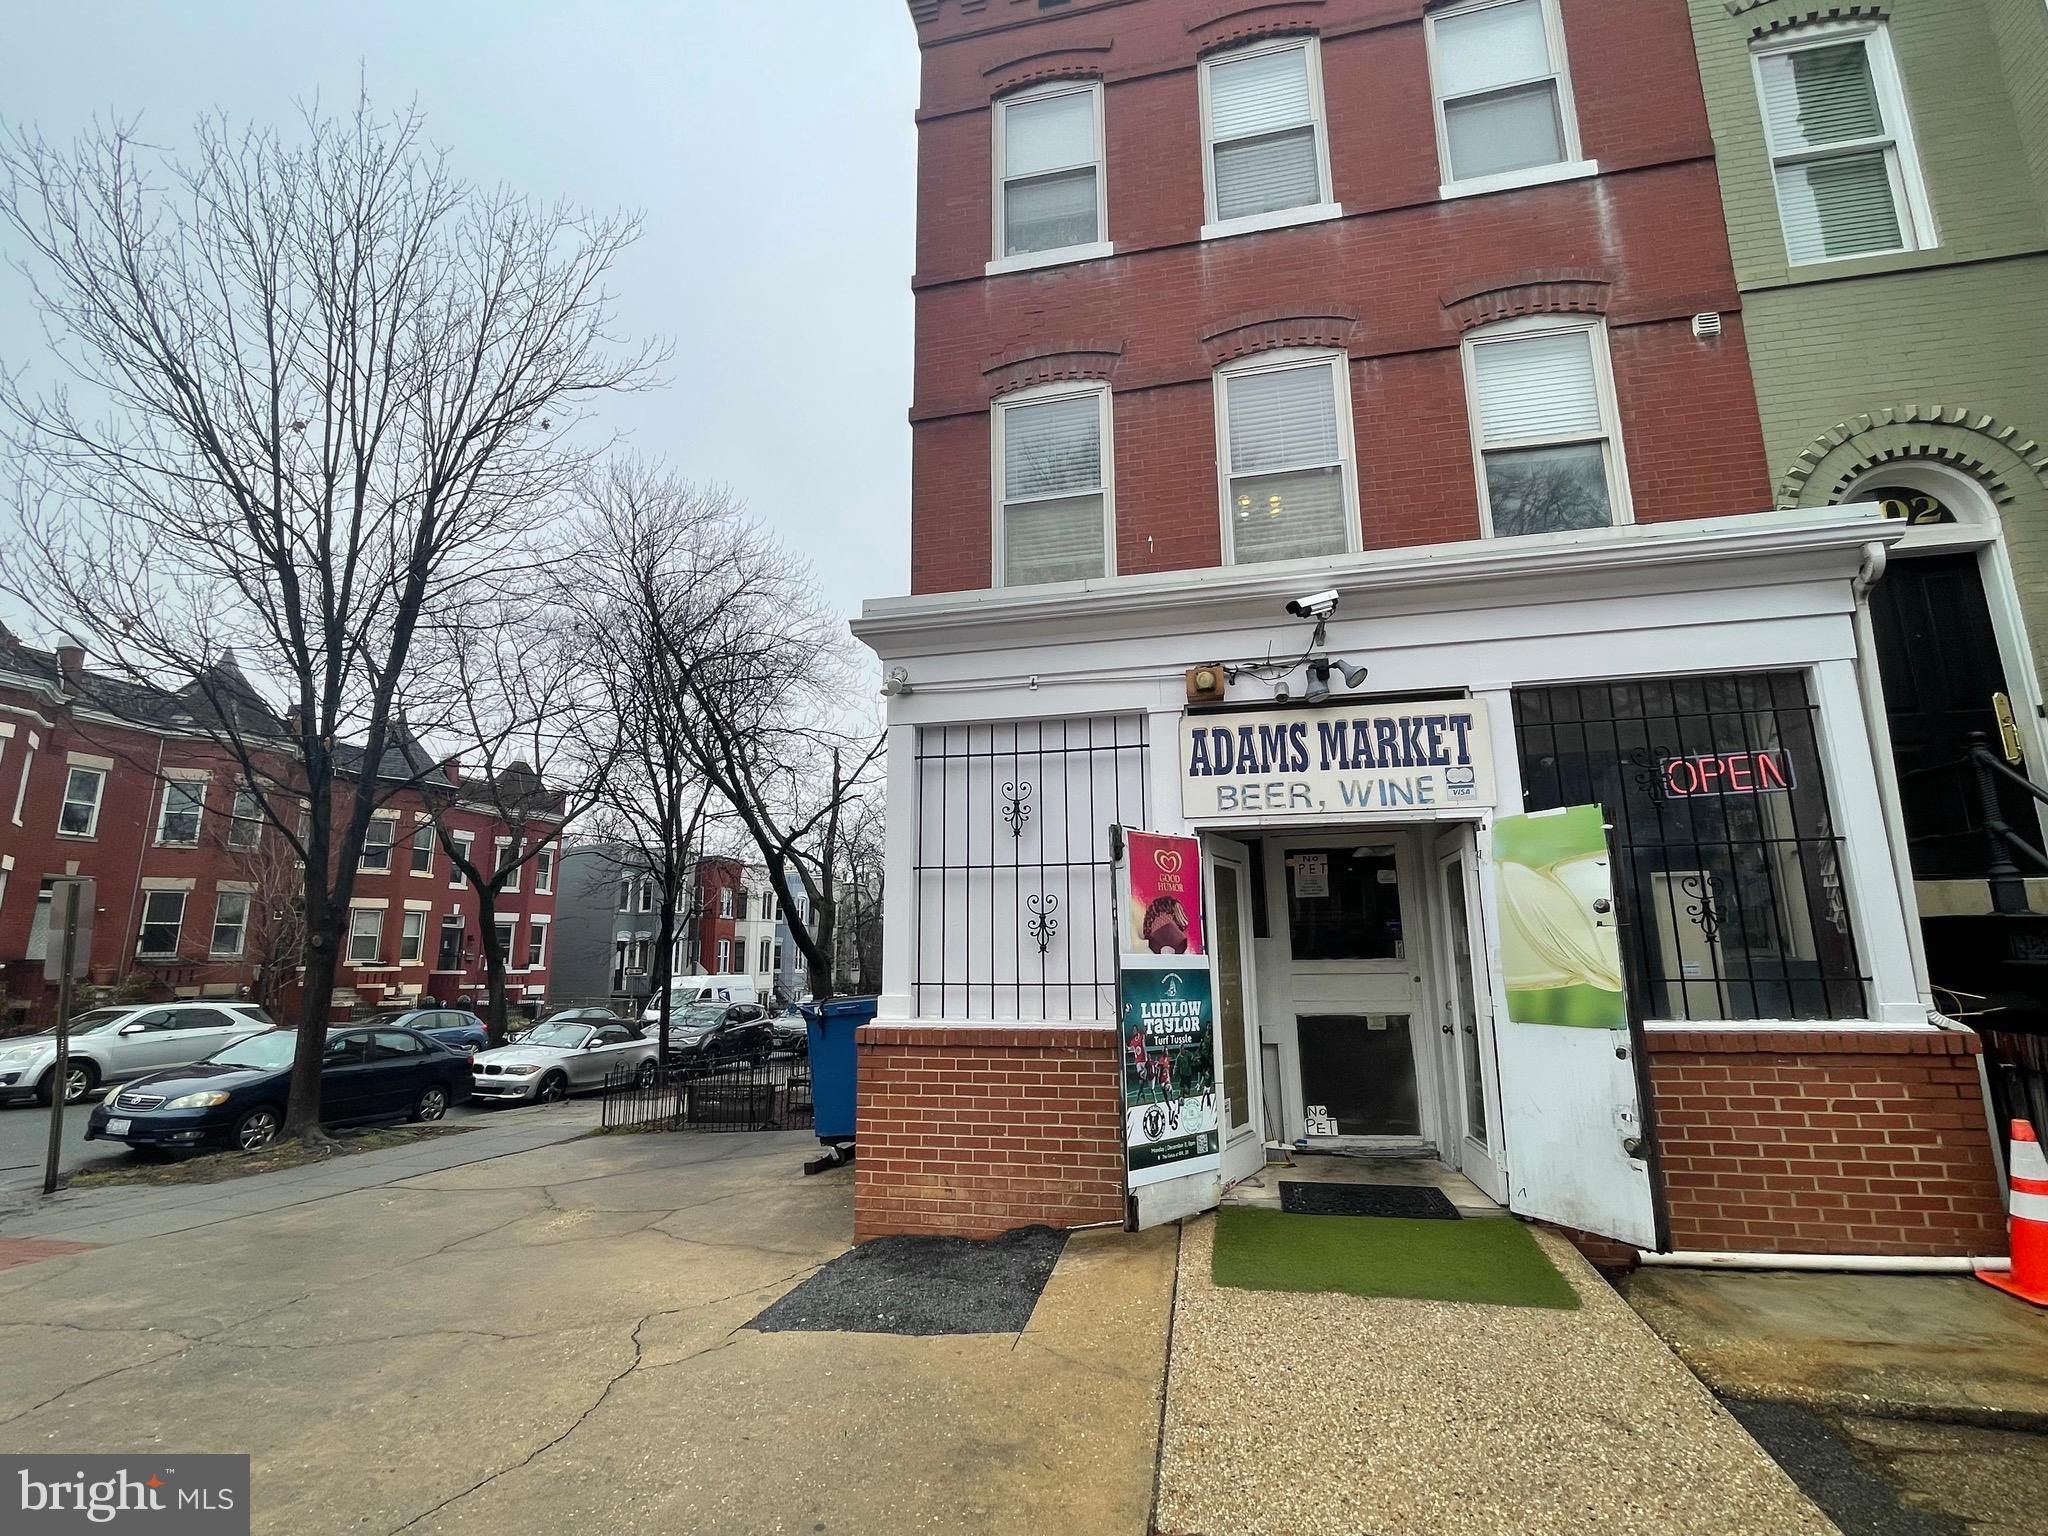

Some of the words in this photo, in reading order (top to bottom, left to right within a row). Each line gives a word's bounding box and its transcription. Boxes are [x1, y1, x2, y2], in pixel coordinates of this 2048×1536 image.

[1189, 722, 1311, 776] ADAMS
[1317, 714, 1473, 771] MARKET
[1668, 754, 1787, 793] OPEN
[1217, 782, 1326, 813] BEER,
[1338, 776, 1435, 807] WINE
[1298, 862, 1328, 875] PET
[1159, 873, 1181, 883] GOOD
[1157, 881, 1184, 893] HUMOR
[1154, 1035, 1169, 1046] Turf
[1170, 1034, 1192, 1044] Tussle
[1305, 1118, 1337, 1135] PET
